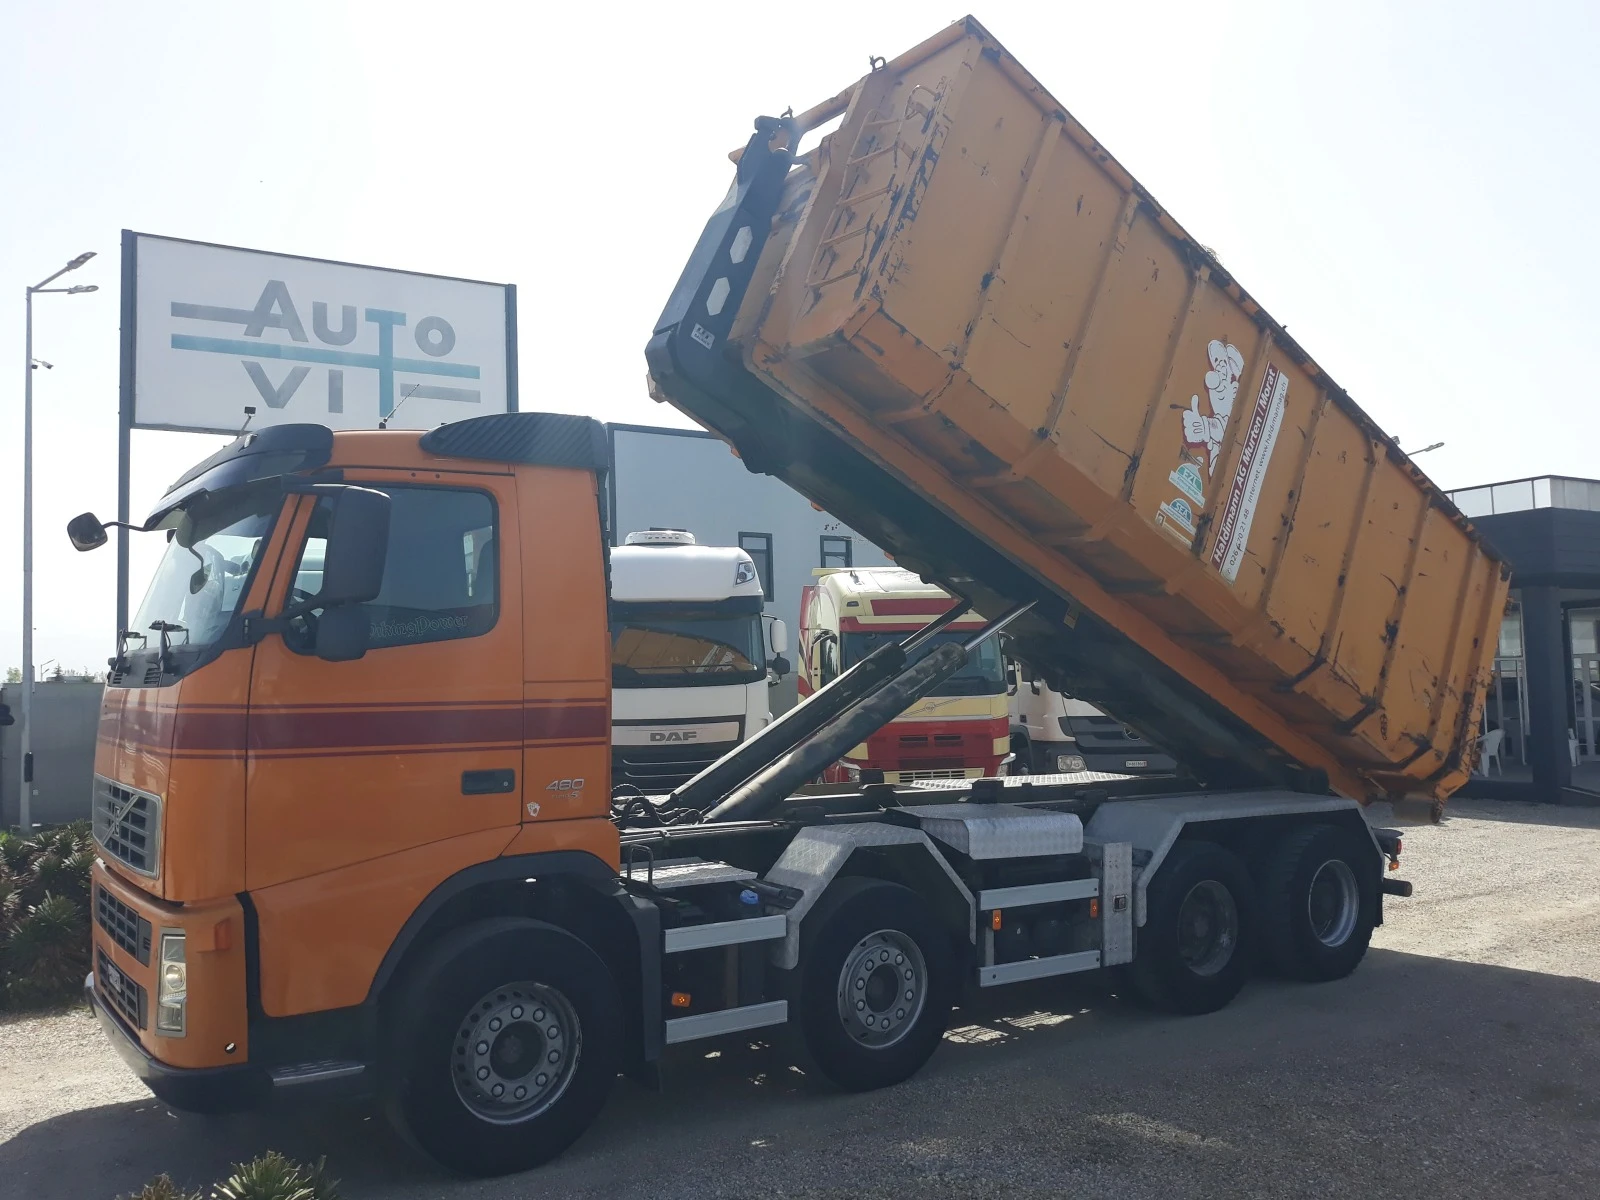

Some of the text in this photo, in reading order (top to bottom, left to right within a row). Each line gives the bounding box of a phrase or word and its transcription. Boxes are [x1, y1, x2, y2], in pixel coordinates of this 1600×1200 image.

[1259, 382, 1287, 467] www.haldimannag.ch
[1214, 489, 1241, 562] Haldimann
[1236, 466, 1247, 489] AG
[1243, 416, 1263, 466] Murten
[1258, 368, 1276, 410] Morat
[1243, 509, 1250, 520] 48
[1240, 521, 1247, 531] 21
[1230, 550, 1239, 566] 026
[650, 731, 697, 742] DAF
